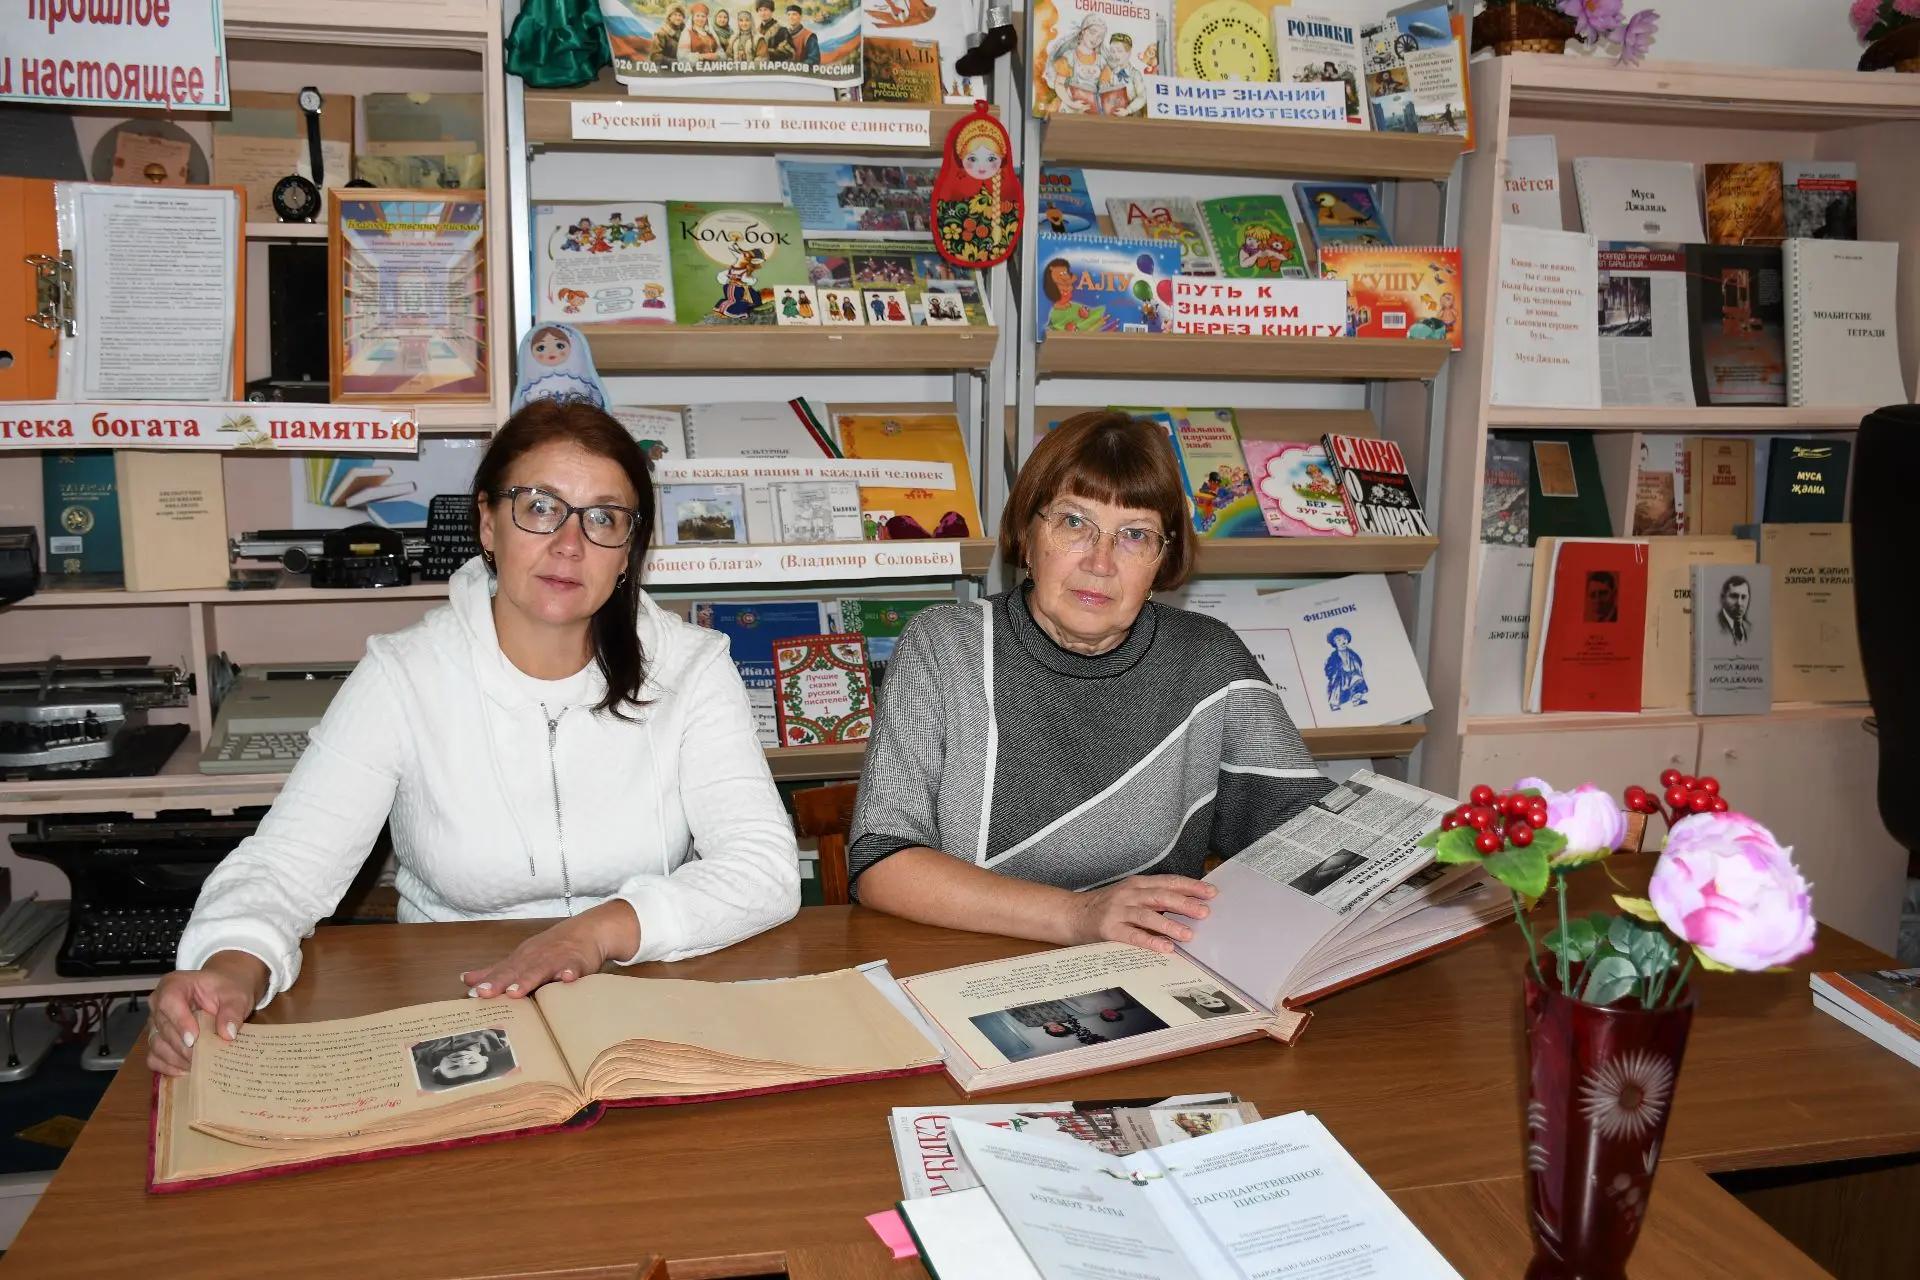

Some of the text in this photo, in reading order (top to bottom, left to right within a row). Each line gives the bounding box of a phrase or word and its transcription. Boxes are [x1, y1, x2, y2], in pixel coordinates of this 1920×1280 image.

[1286, 19, 1355, 45] РОДНИКИ
[636, 62, 658, 73] ГОД
[671, 61, 694, 73] ГОД
[695, 61, 756, 72] ЕДИНСТВА
[760, 61, 810, 73] НАРОДОВ
[812, 62, 855, 75] РОССИИ
[22, 58, 204, 112] настоящее
[1155, 83, 1326, 102] В МИР ЗНАНИЙ
[1157, 102, 1345, 121] С БИБЛИОТЕКОЙ!
[581, 111, 661, 130] «Русский
[667, 116, 716, 131] народ
[743, 119, 770, 130] это
[780, 119, 847, 131] великое
[850, 120, 929, 135] единство,
[1631, 188, 1656, 201] Муса
[1127, 202, 1173, 225] Аа
[1624, 201, 1667, 214] Джалиль
[1075, 271, 1135, 292] АЛУ
[1352, 271, 1425, 292] КУШУ
[1177, 283, 1273, 299] ПУТЬ К
[1178, 302, 1299, 318] ЗНАНИЯМ
[1813, 311, 1872, 321] МОАБИТСКИЕ
[1177, 321, 1343, 337] ЧЕРЕЗ КНИГУ
[1847, 328, 1886, 338] ТЕТРАДИ
[0, 413, 418, 442] тека богата памятью
[1332, 434, 1406, 475] СЛОВО
[663, 468, 944, 480] где каждая нация и каждый человек
[1797, 471, 1823, 482] МУСА
[1344, 469, 1364, 503] О
[1296, 507, 1318, 515] ЗУР
[1306, 500, 1327, 508] БЕР
[1355, 502, 1433, 537] СЛОВАХ
[647, 551, 954, 573] общего блага» (Владимир Соловьёв)
[1789, 567, 1814, 575] МУСА
[1303, 603, 1358, 622] ФИЛИПОК
[1713, 664, 1733, 672] МУСА
[805, 673, 839, 682] Лучшие
[809, 681, 838, 690] сказки
[1709, 676, 1729, 684] МУСА
[803, 695, 848, 706] писателей
[808, 688, 841, 697] русских
[823, 706, 830, 715] 1
[1233, 1188, 1291, 1209] ПИСЬМО
